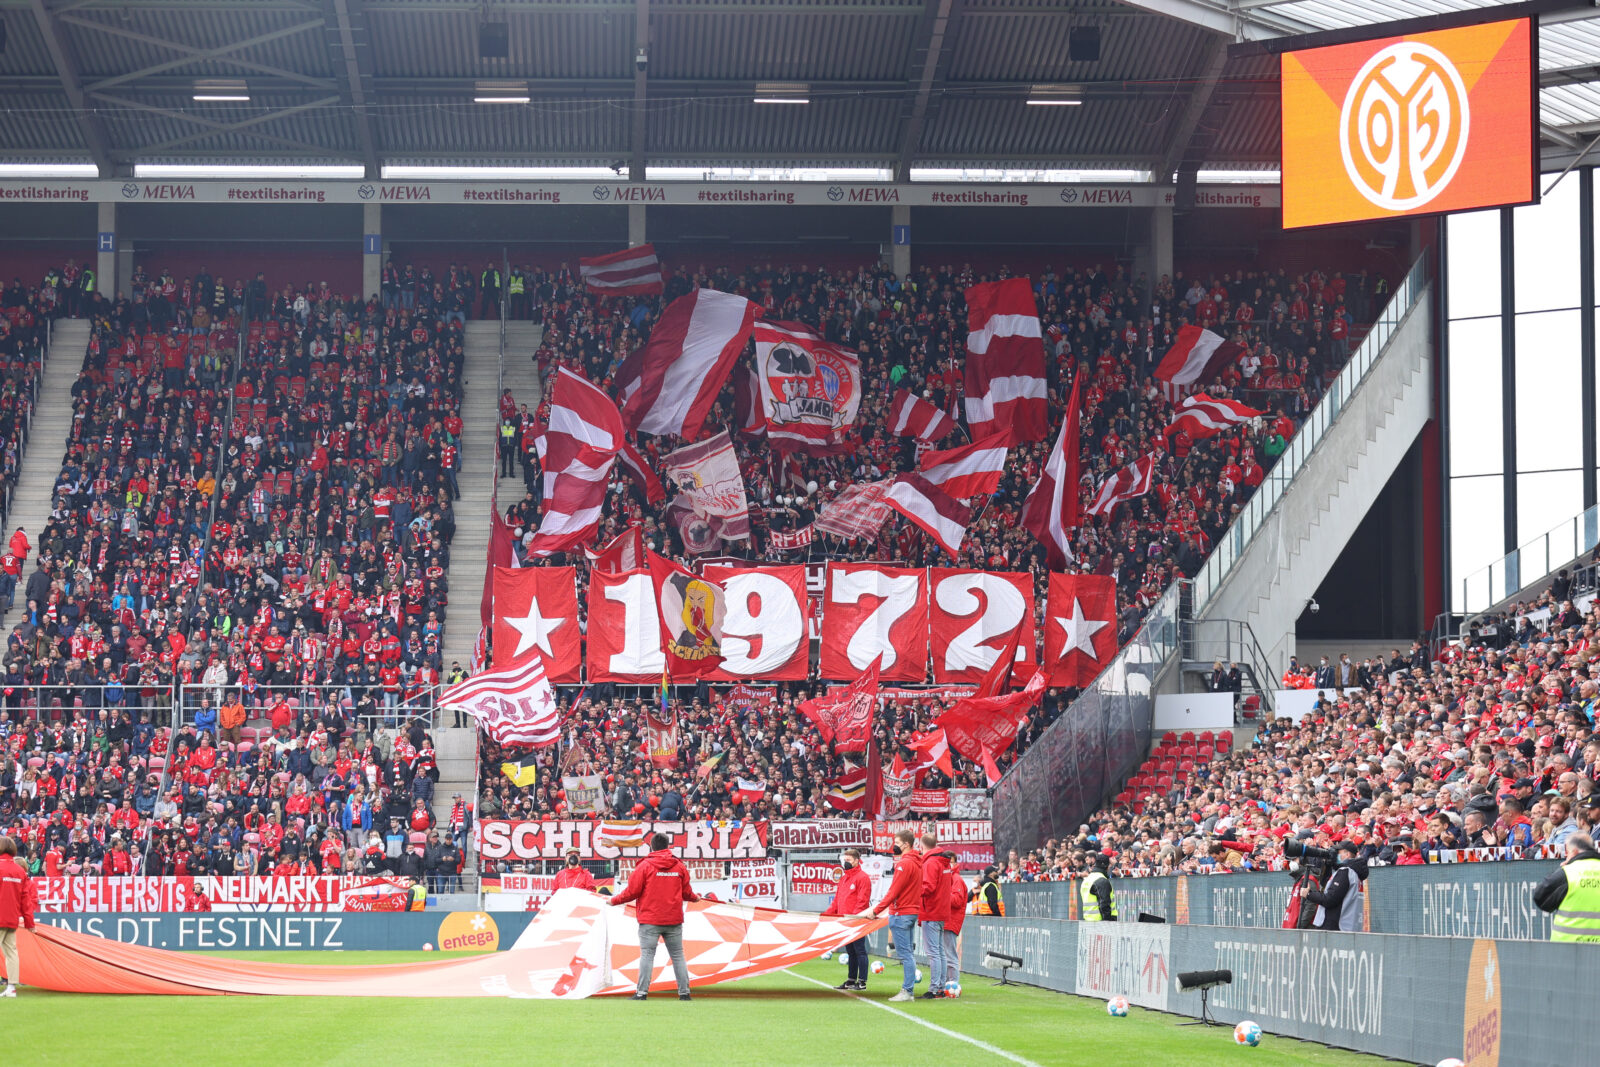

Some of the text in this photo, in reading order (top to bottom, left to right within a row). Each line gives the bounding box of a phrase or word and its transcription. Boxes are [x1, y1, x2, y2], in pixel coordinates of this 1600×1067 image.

[142, 185, 196, 199] MEWA
[227, 187, 326, 202] #textilsharing
[379, 186, 431, 200] MEWA
[463, 188, 560, 203] #textilsharing
[614, 186, 666, 201] MEWA
[698, 189, 795, 204] #textilsharing
[848, 187, 900, 202] MEWA
[931, 190, 1028, 206] #textilsharing
[1081, 189, 1133, 204] MEWA
[1164, 191, 1261, 207] #tilsharing
[100, 235, 113, 250] H
[899, 228, 905, 244] J
[741, 685, 772, 698] Bayern
[936, 822, 993, 842] COLEGIO
[695, 869, 723, 881] UNS
[732, 868, 775, 879] BEI DIR
[209, 875, 339, 903] NEUMARKT
[503, 876, 528, 890] RED
[1422, 881, 1470, 937] ENTEGA
[117, 917, 167, 947] DT.
[179, 917, 343, 947] FESTNETZ
[443, 929, 495, 951] entega
[1299, 935, 1384, 1036] ÖKOSTROM
[1466, 1008, 1498, 1063] entega
